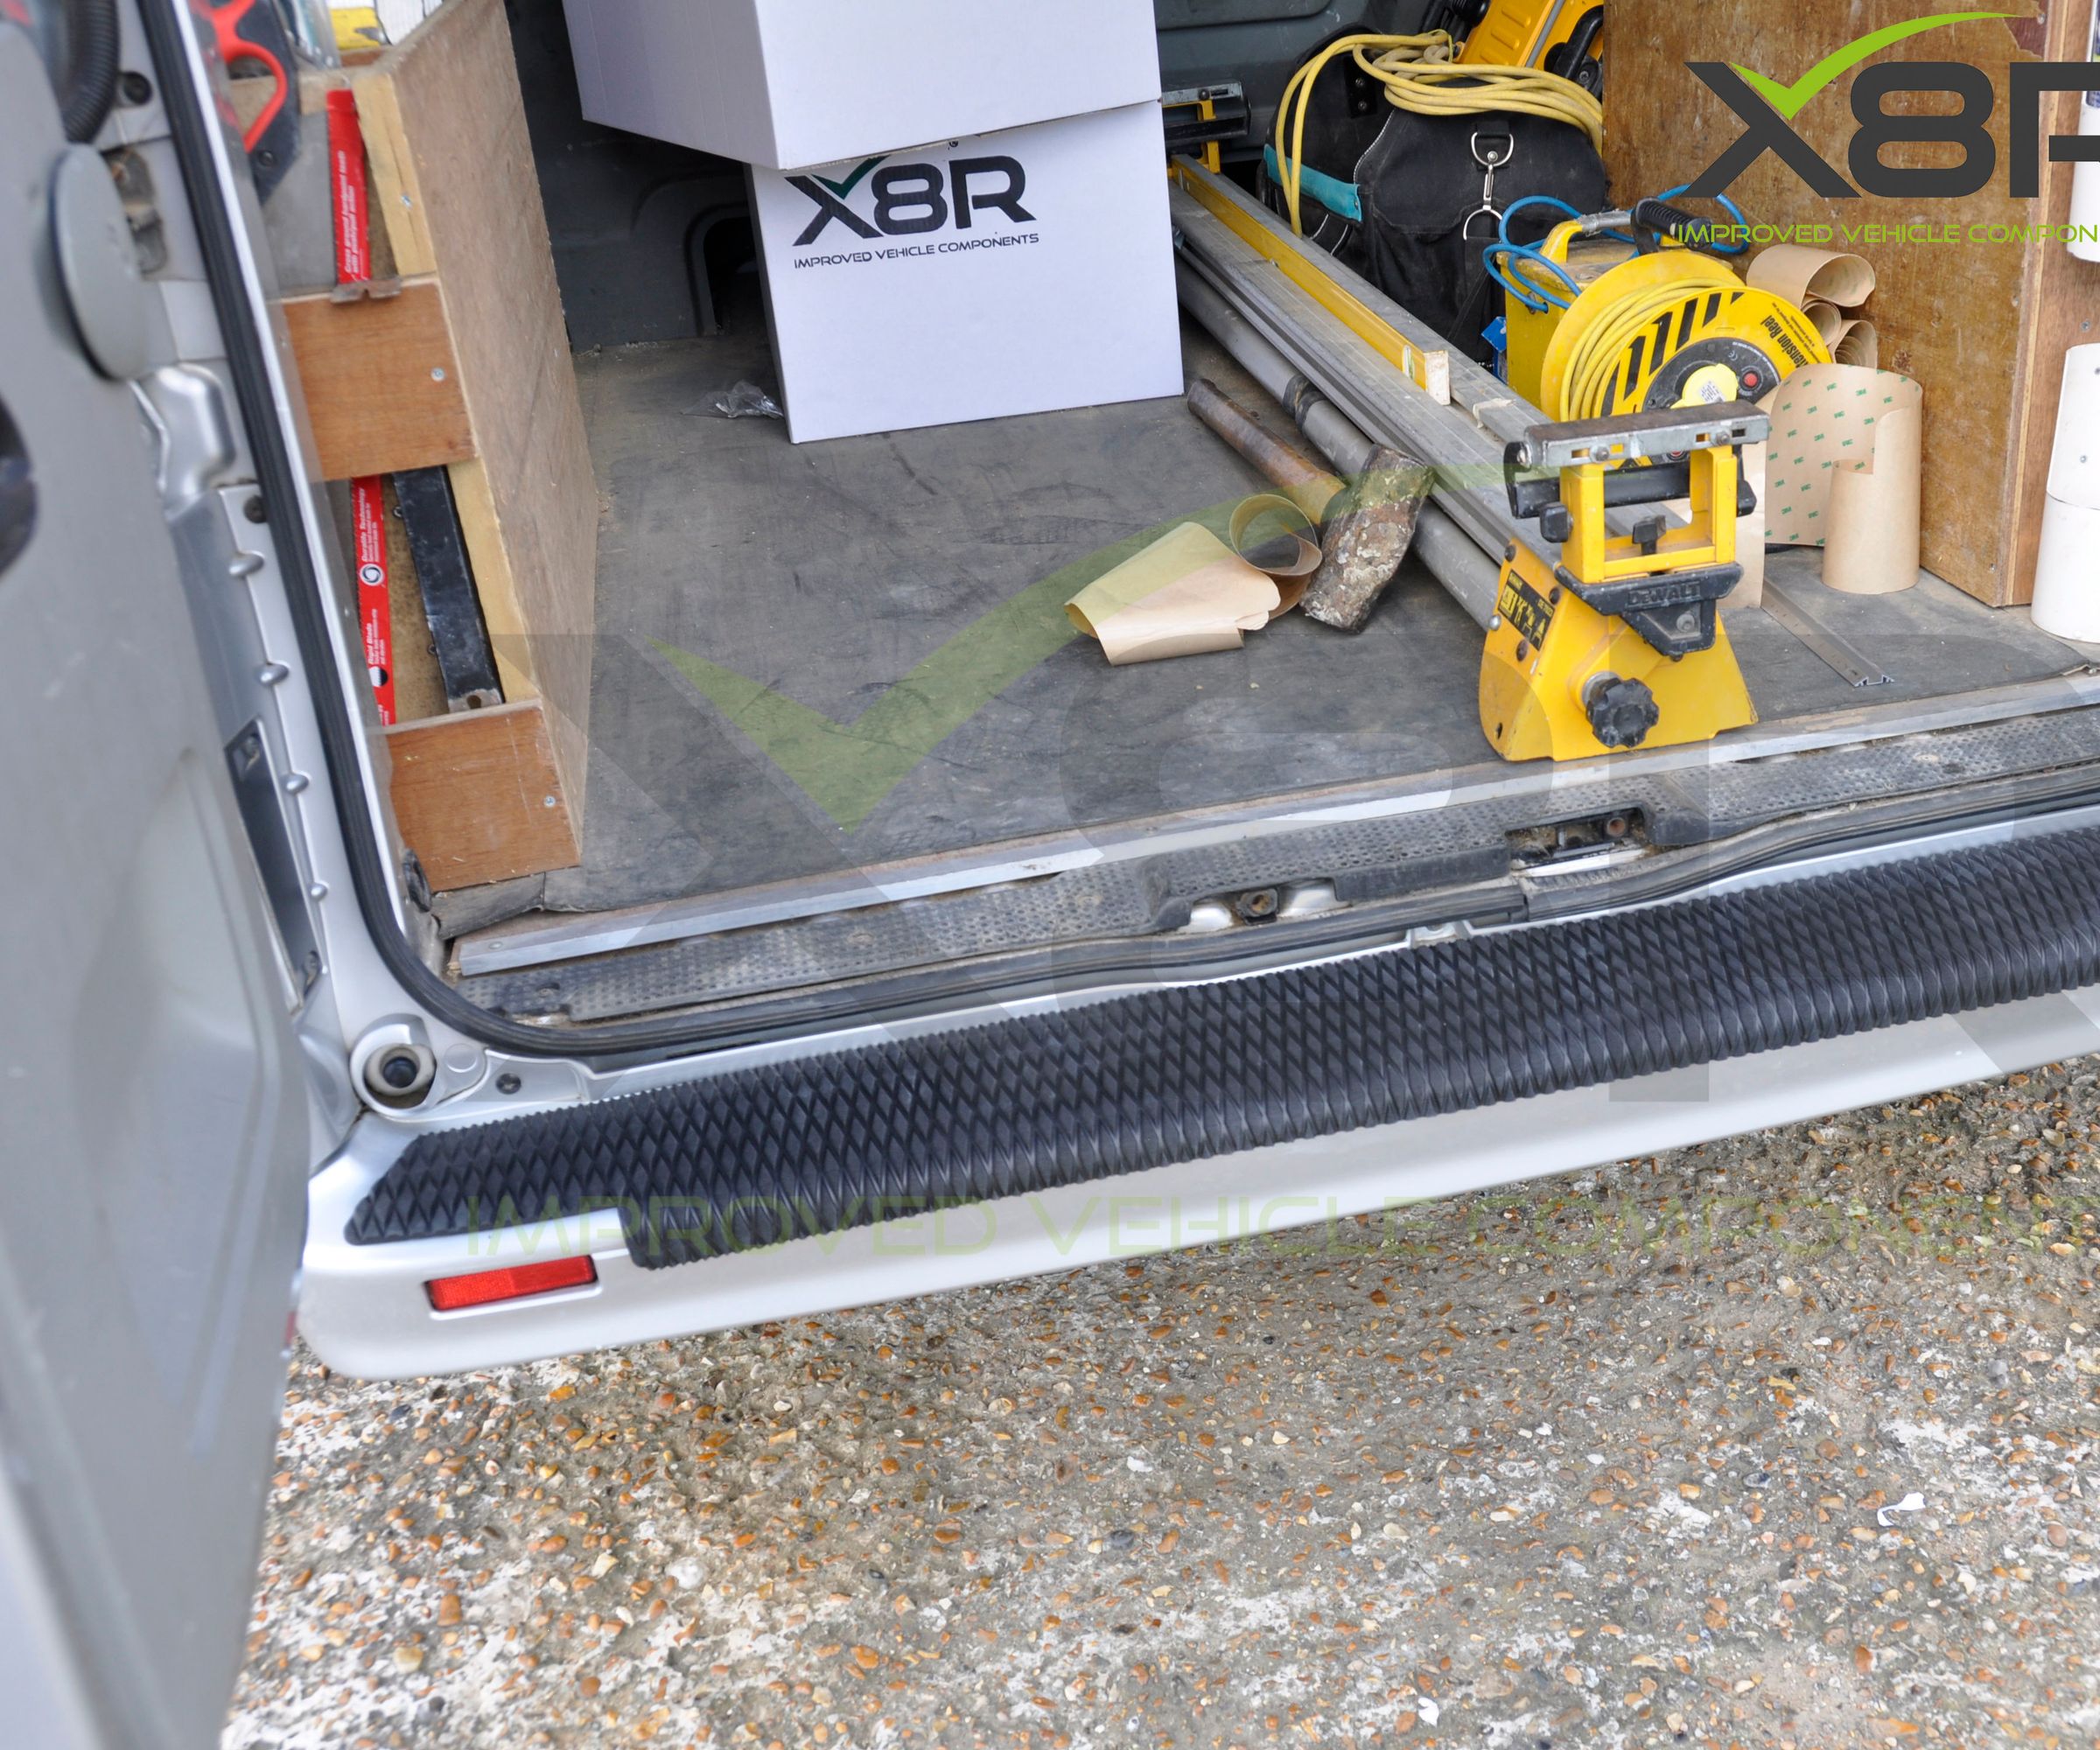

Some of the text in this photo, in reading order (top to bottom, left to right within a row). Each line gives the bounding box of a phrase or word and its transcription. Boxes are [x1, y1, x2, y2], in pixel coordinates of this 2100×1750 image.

[784, 154, 1037, 247] X8R
[794, 233, 1040, 270] IMPROVED VEHICLE COMPONENTS
[1760, 315, 1782, 339] Reel
[358, 487, 367, 530] Technology
